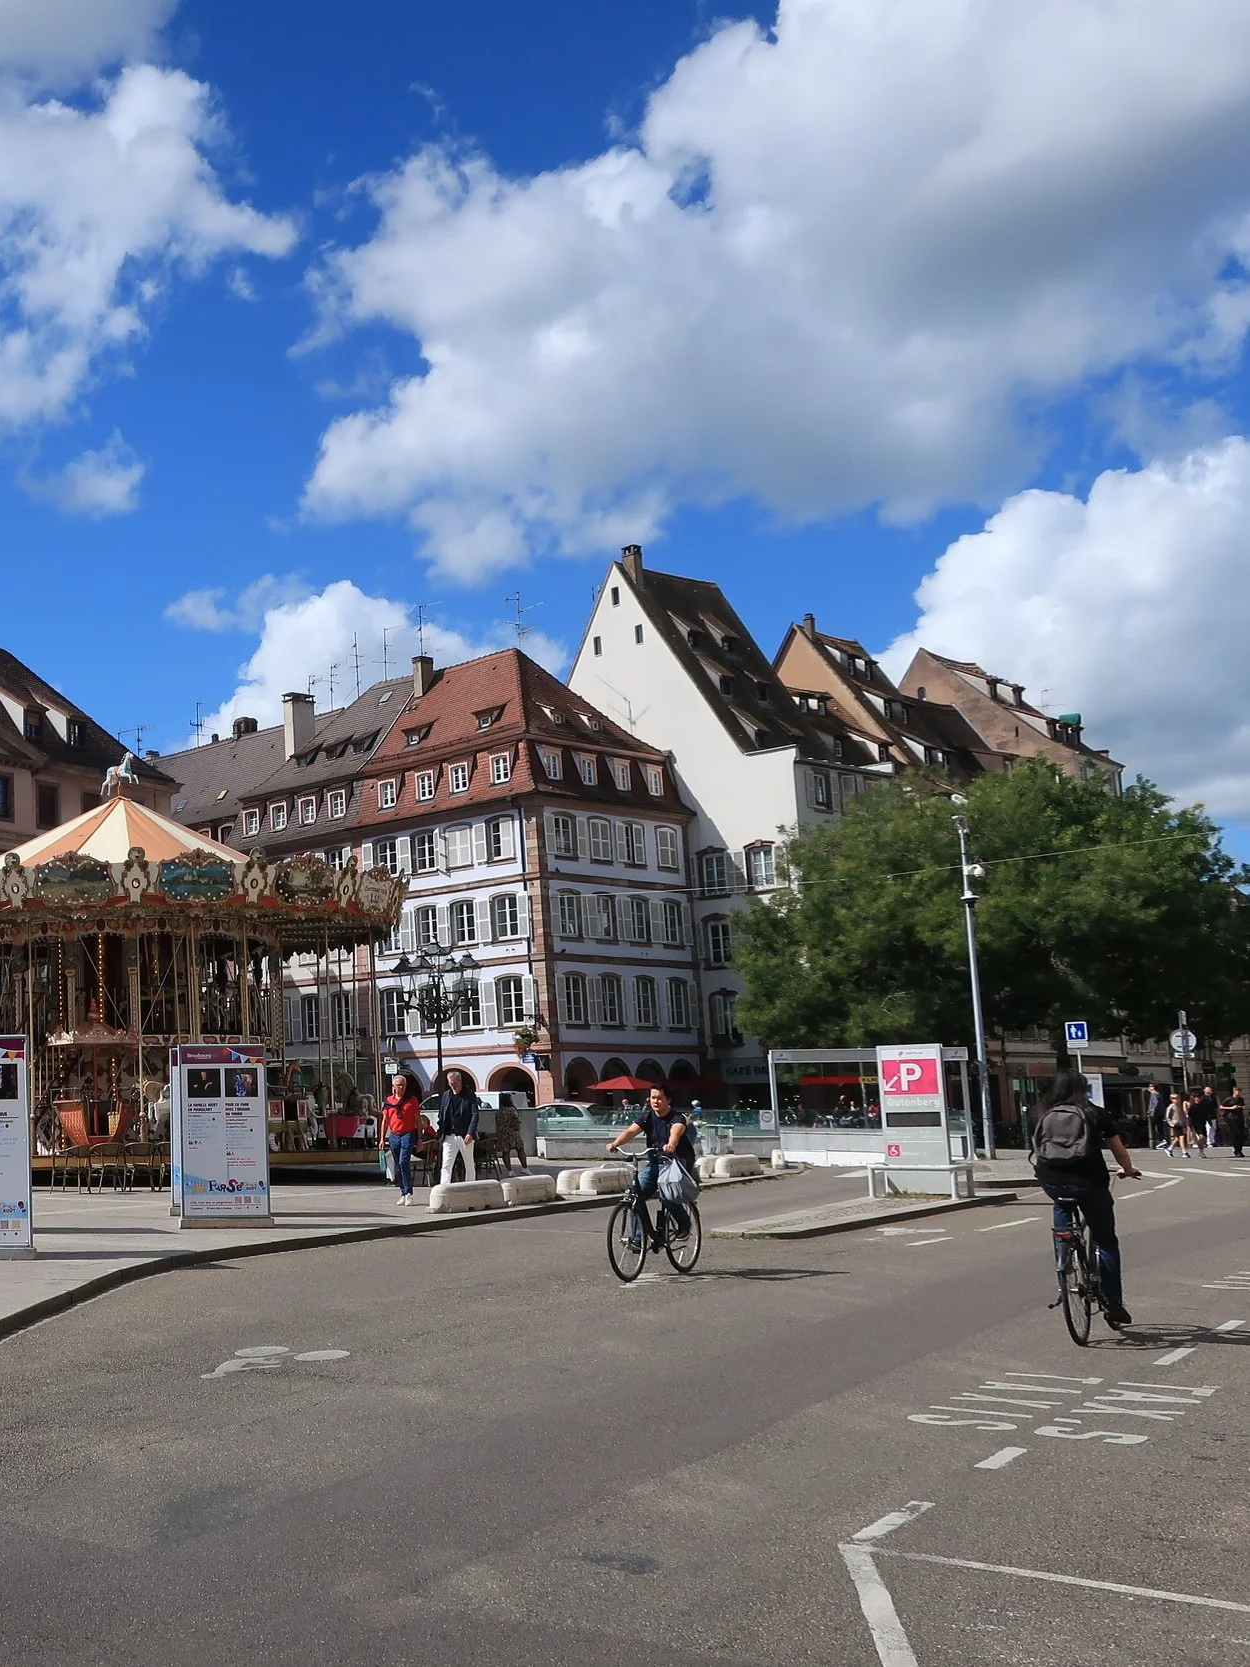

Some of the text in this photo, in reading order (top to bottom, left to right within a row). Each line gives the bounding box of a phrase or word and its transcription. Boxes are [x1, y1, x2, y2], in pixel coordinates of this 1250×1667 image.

[726, 1062, 752, 1076] CAFÉ
[899, 1063, 923, 1091] P
[887, 1098, 940, 1108] Gutenberg
[907, 1372, 1104, 1431] TAXIS
